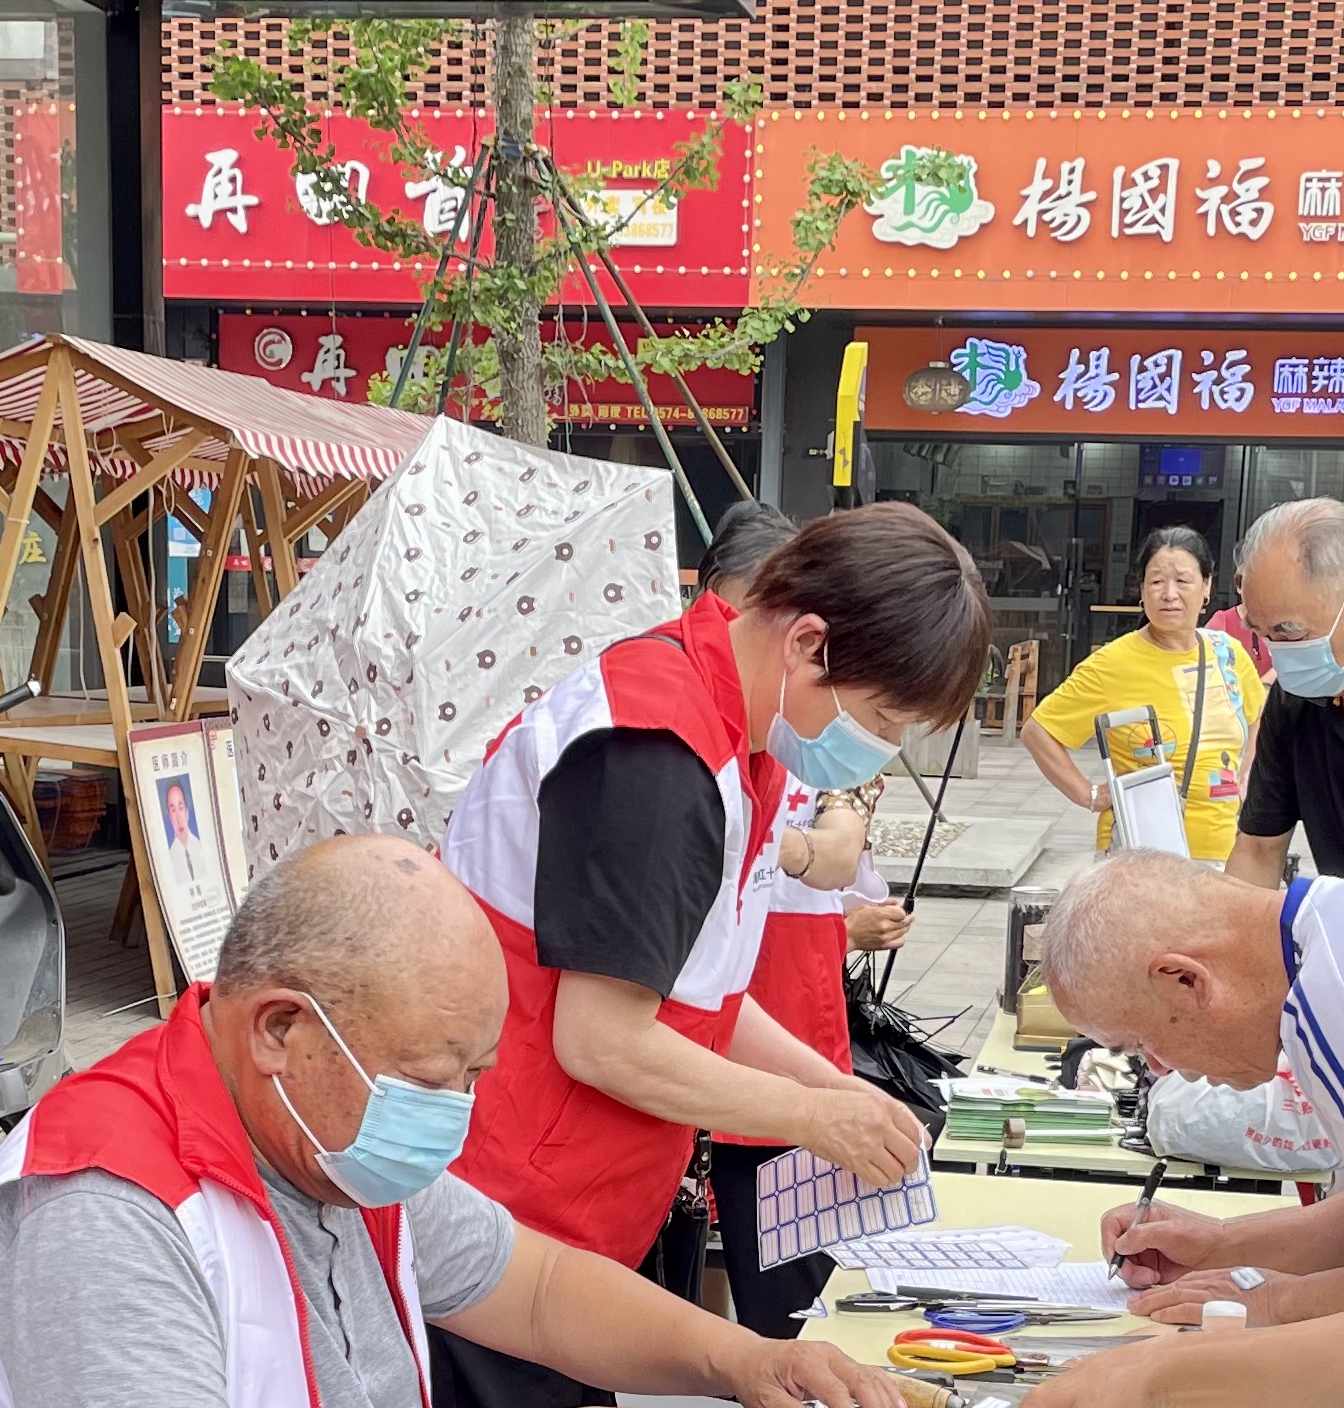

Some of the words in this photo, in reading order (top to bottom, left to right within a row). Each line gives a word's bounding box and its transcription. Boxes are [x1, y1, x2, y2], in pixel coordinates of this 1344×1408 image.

[1012, 155, 1276, 243] 楊國福
[1298, 222, 1336, 241] YGF
[1054, 347, 1256, 416] 楊國福
